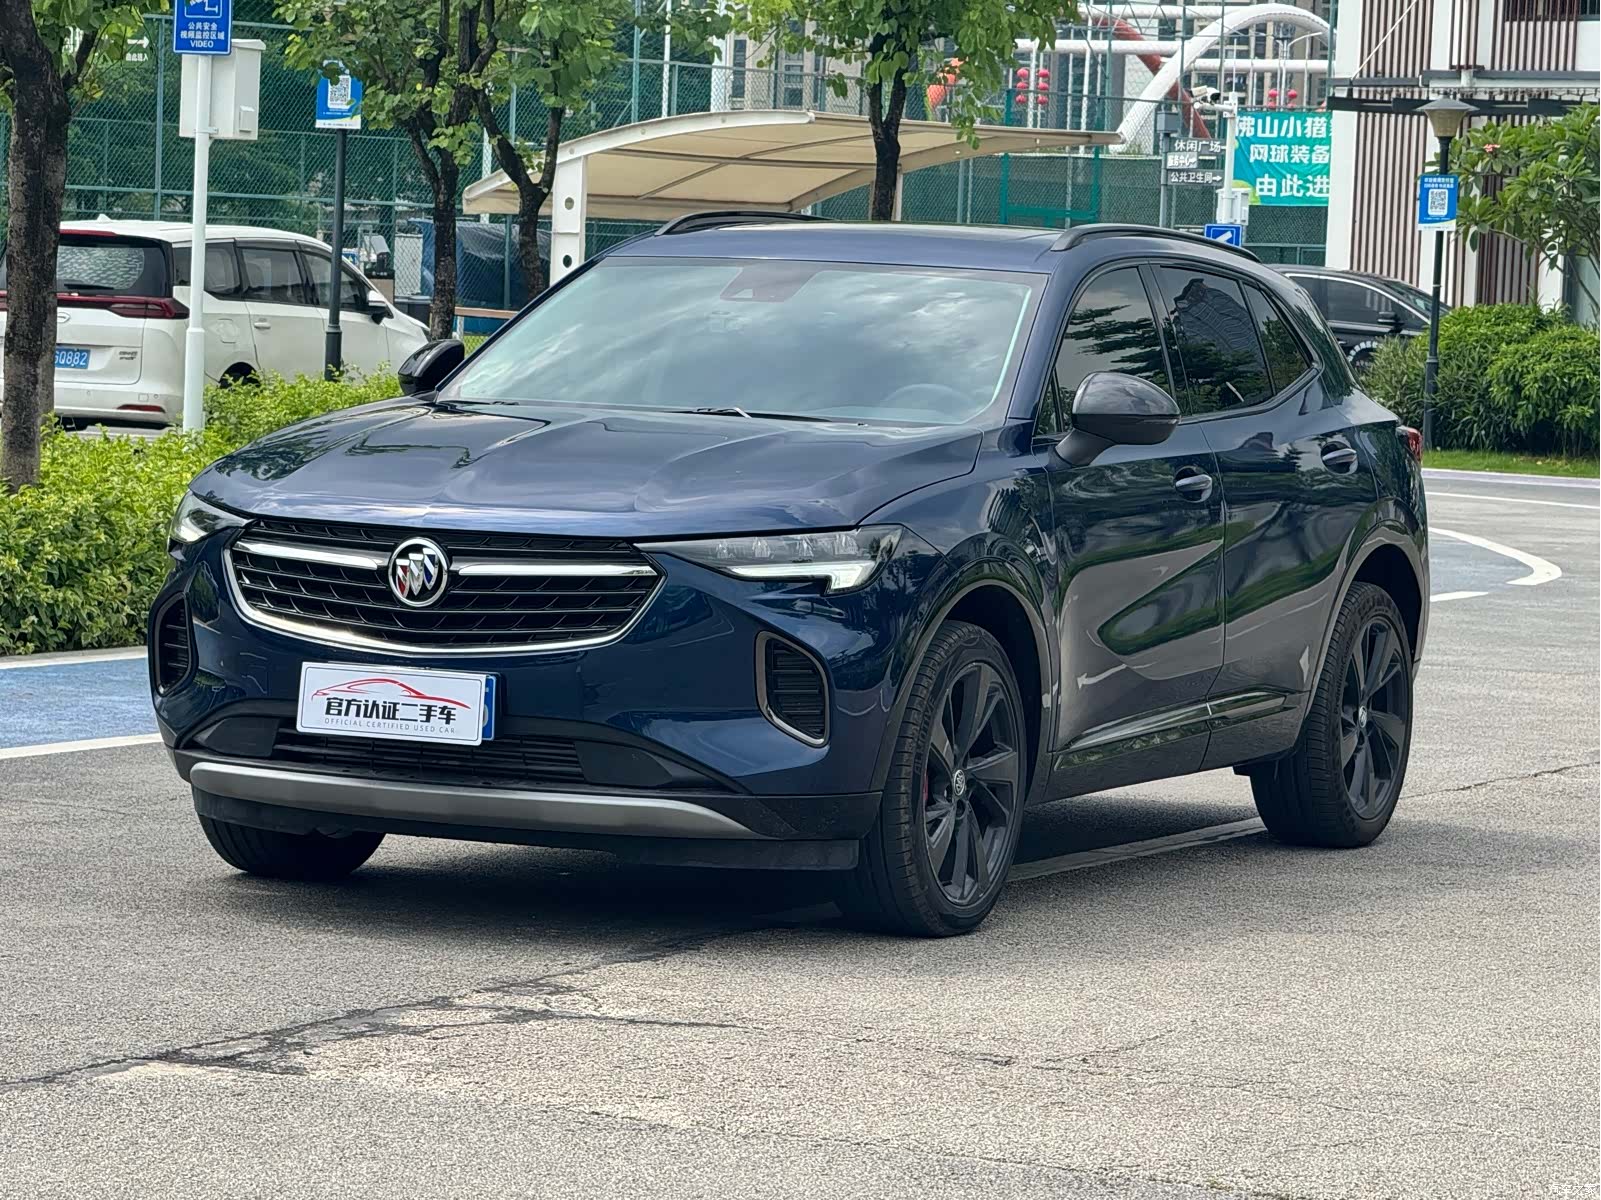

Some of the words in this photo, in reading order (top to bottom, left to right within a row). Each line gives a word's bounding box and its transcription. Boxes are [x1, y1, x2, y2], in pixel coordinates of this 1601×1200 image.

[188, 22, 218, 31] 公共安全
[180, 31, 225, 40] 视频监控区域
[190, 40, 214, 48] VIDEO
[1235, 116, 1333, 138] 佛山小猎
[1174, 140, 1221, 152] 休闲广场
[1249, 144, 1330, 164] 网球装备
[1171, 171, 1213, 183] 公共卫生间
[1255, 174, 1330, 197] 由此进
[325, 697, 456, 725] 官方认证二手车
[325, 718, 361, 727] OFFICIAL
[366, 721, 410, 730] CERTIFIED
[413, 724, 436, 732] USED
[439, 726, 455, 734] CAR
